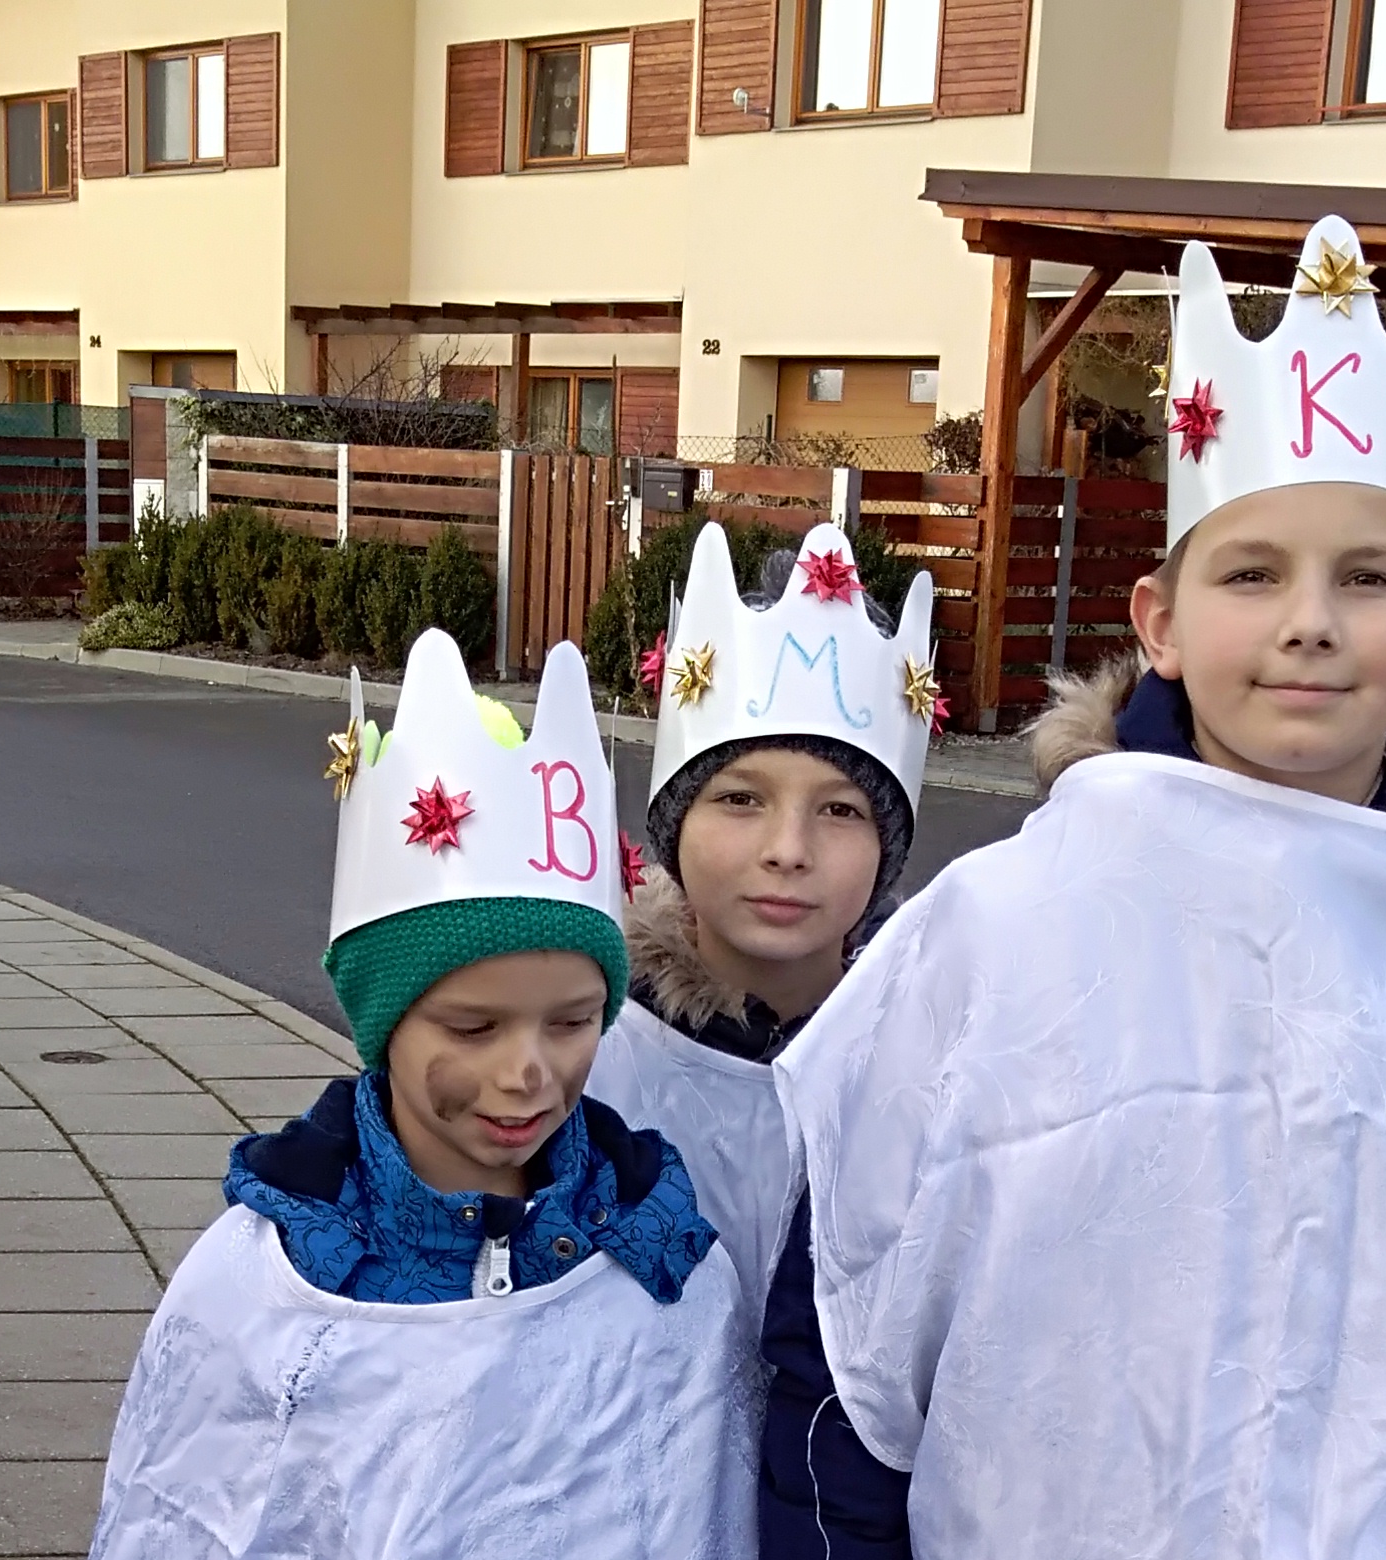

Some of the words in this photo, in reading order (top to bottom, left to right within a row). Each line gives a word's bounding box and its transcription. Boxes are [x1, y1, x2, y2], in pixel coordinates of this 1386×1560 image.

[702, 339, 720, 355] 22
[1290, 350, 1373, 458] K
[746, 631, 872, 729] M
[528, 761, 598, 882] B
